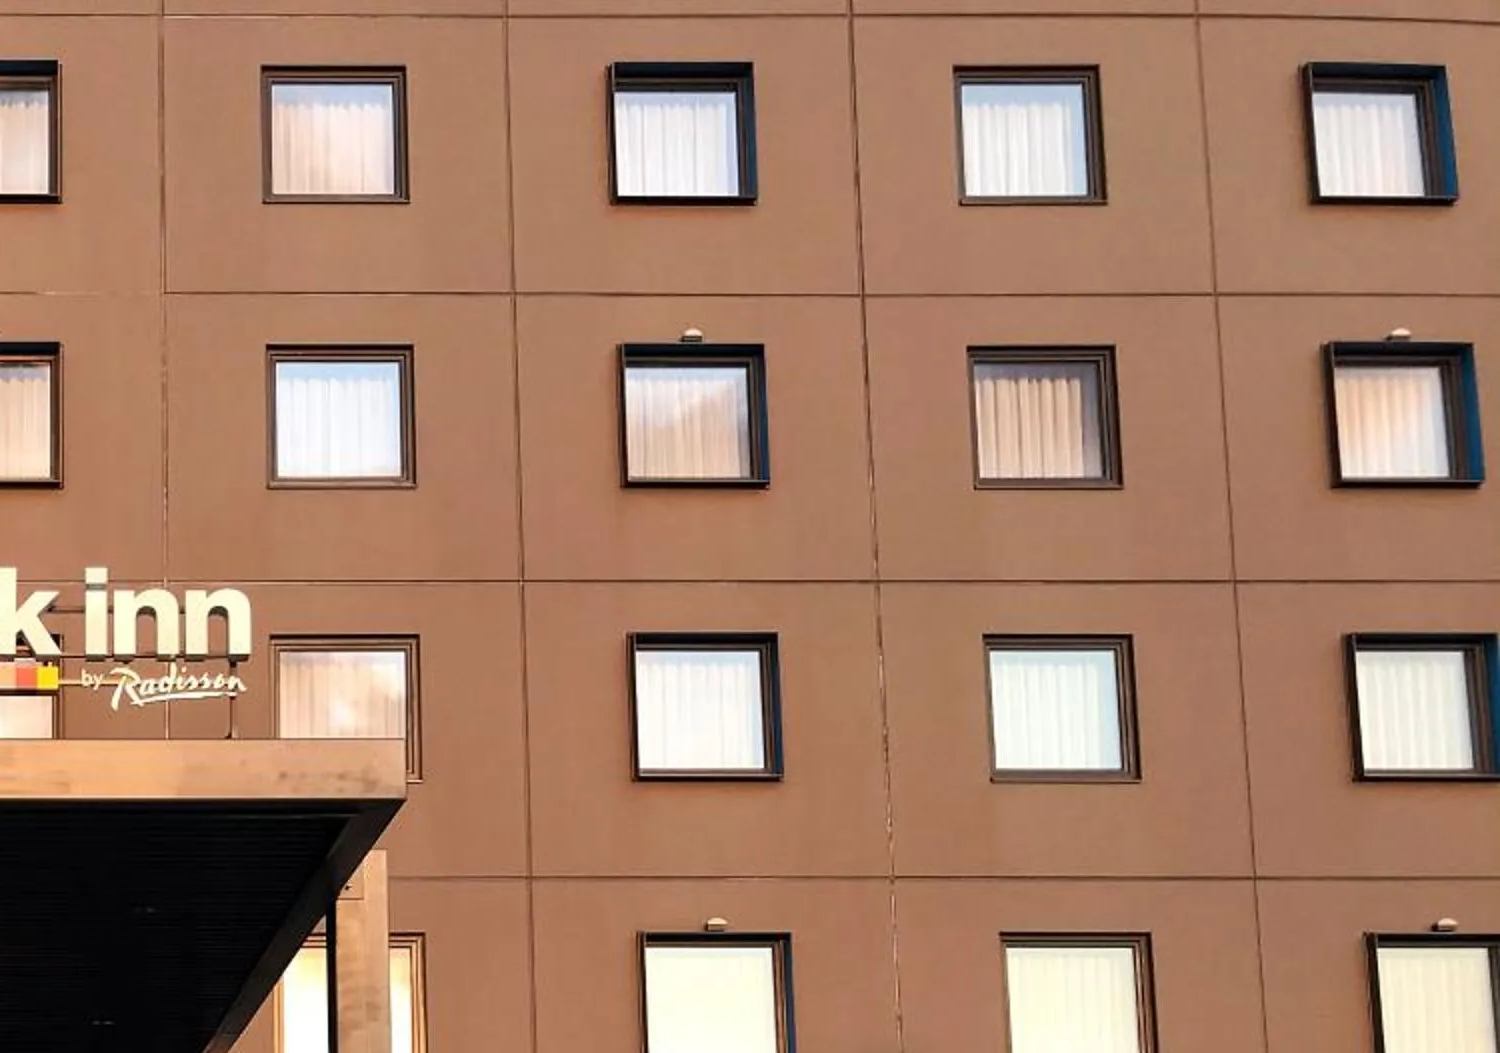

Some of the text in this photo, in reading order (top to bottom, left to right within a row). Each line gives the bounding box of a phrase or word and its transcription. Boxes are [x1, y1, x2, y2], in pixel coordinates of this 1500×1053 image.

[85, 567, 251, 656] inn
[81, 661, 247, 711] by Radisson
